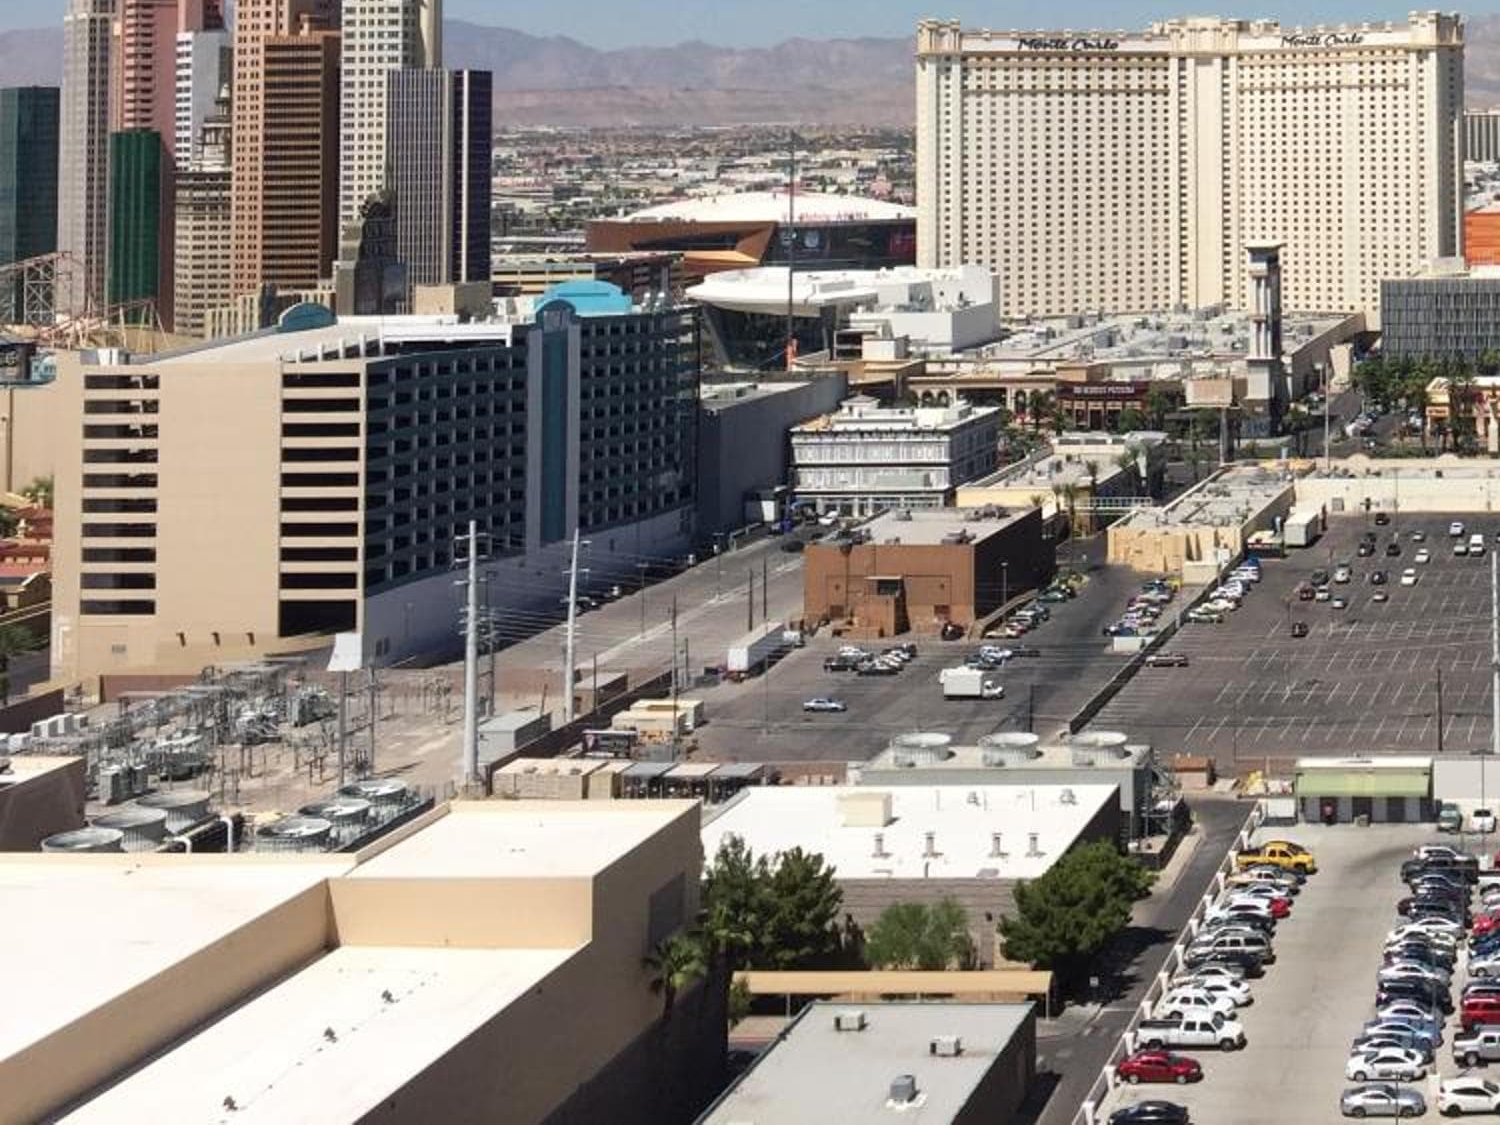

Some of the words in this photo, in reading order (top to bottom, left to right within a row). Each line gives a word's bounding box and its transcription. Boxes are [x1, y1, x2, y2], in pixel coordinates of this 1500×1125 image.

[1018, 38, 1069, 50] Monte
[1072, 38, 1119, 51] Carlo
[1280, 34, 1321, 47] Monte
[1324, 32, 1364, 48] Carlo
